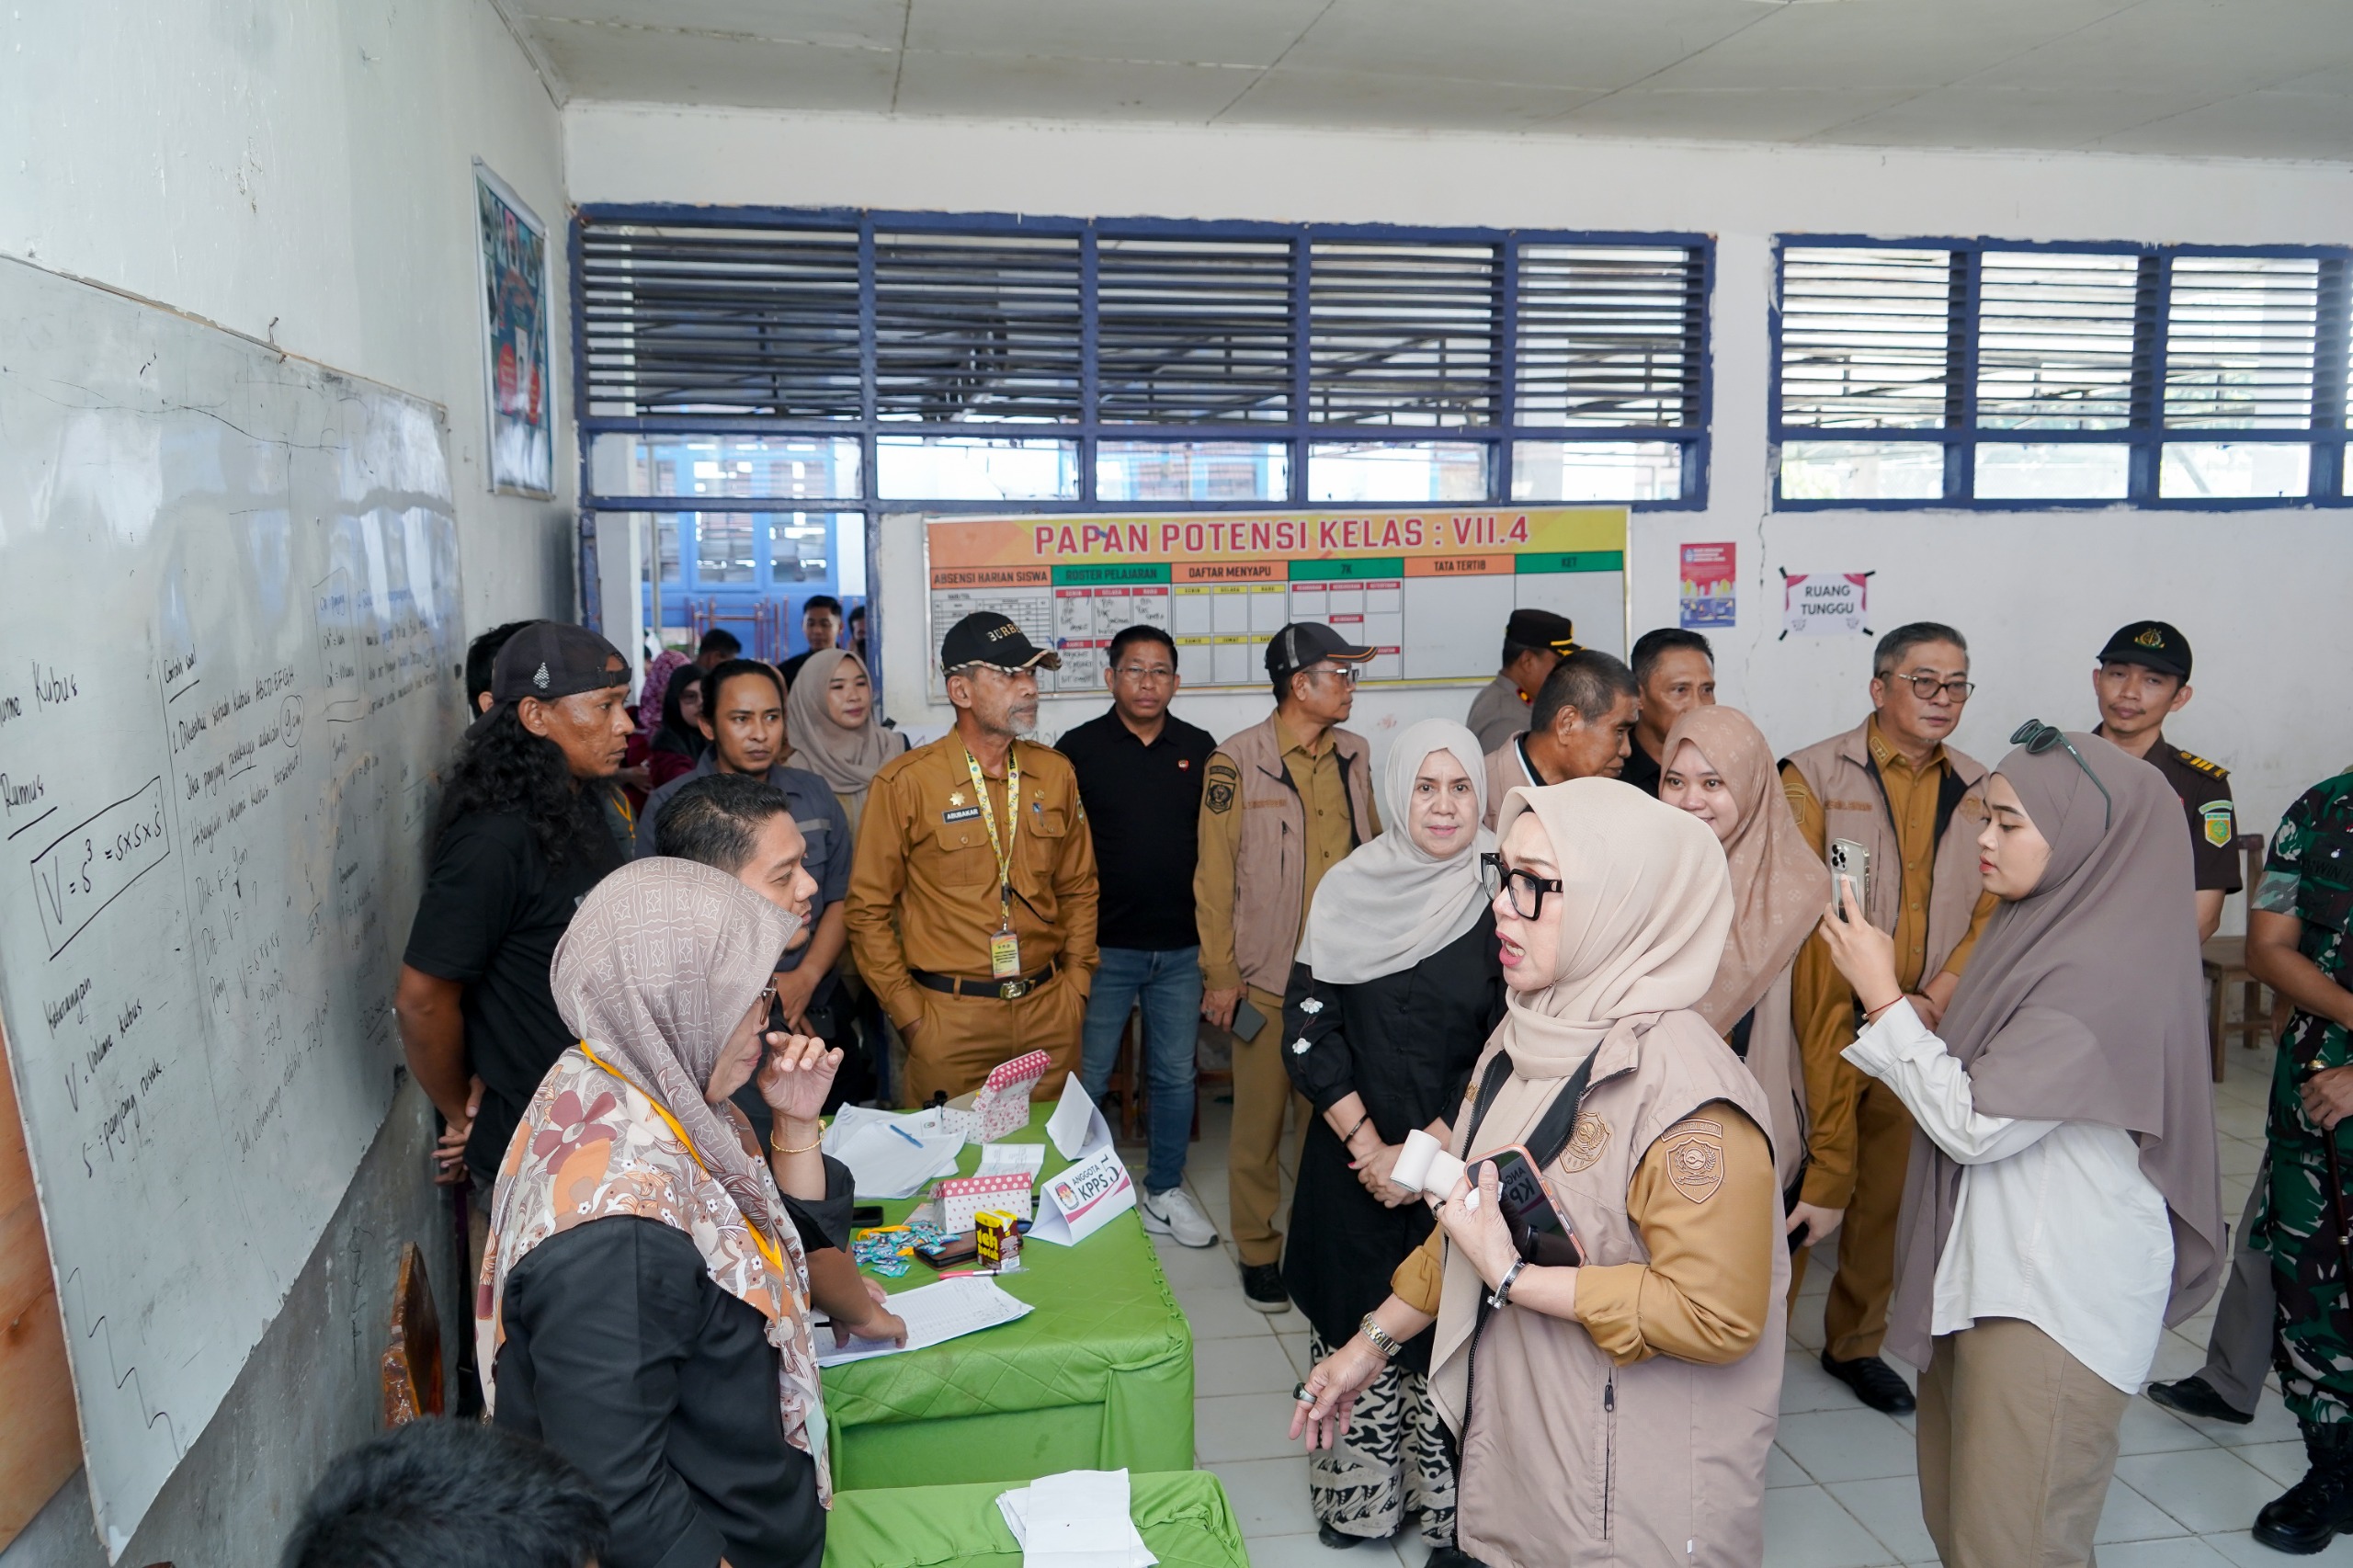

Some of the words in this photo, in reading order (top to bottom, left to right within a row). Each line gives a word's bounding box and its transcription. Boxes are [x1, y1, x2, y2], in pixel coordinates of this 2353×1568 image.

[1035, 523, 1148, 554] PAPAN
[1162, 521, 1306, 551] POTENSI
[1320, 518, 1423, 549] KELAS
[1453, 516, 1529, 544] VII.4
[1065, 568, 1102, 581] ROSTER
[1105, 567, 1157, 580] PELAJARAN
[1188, 566, 1223, 578] DAFTAR
[1226, 565, 1271, 577] MENYAPU
[1434, 561, 1454, 572] TATA
[1457, 559, 1486, 571] TERTIB
[934, 571, 975, 585] ABSENSI
[978, 569, 1013, 584] HARIAN
[1017, 568, 1048, 582] SISWA
[1805, 585, 1850, 597] RUANG
[1801, 603, 1855, 616] TUNGGU
[32, 661, 77, 712] Kubus
[0, 772, 44, 818] Rumus
[947, 808, 979, 820] ABUBAKAR
[1072, 1164, 1100, 1186] ANGGOTA
[1077, 1173, 1108, 1201] KPPS
[1100, 1153, 1120, 1184] 5
[976, 1226, 999, 1251] teh
